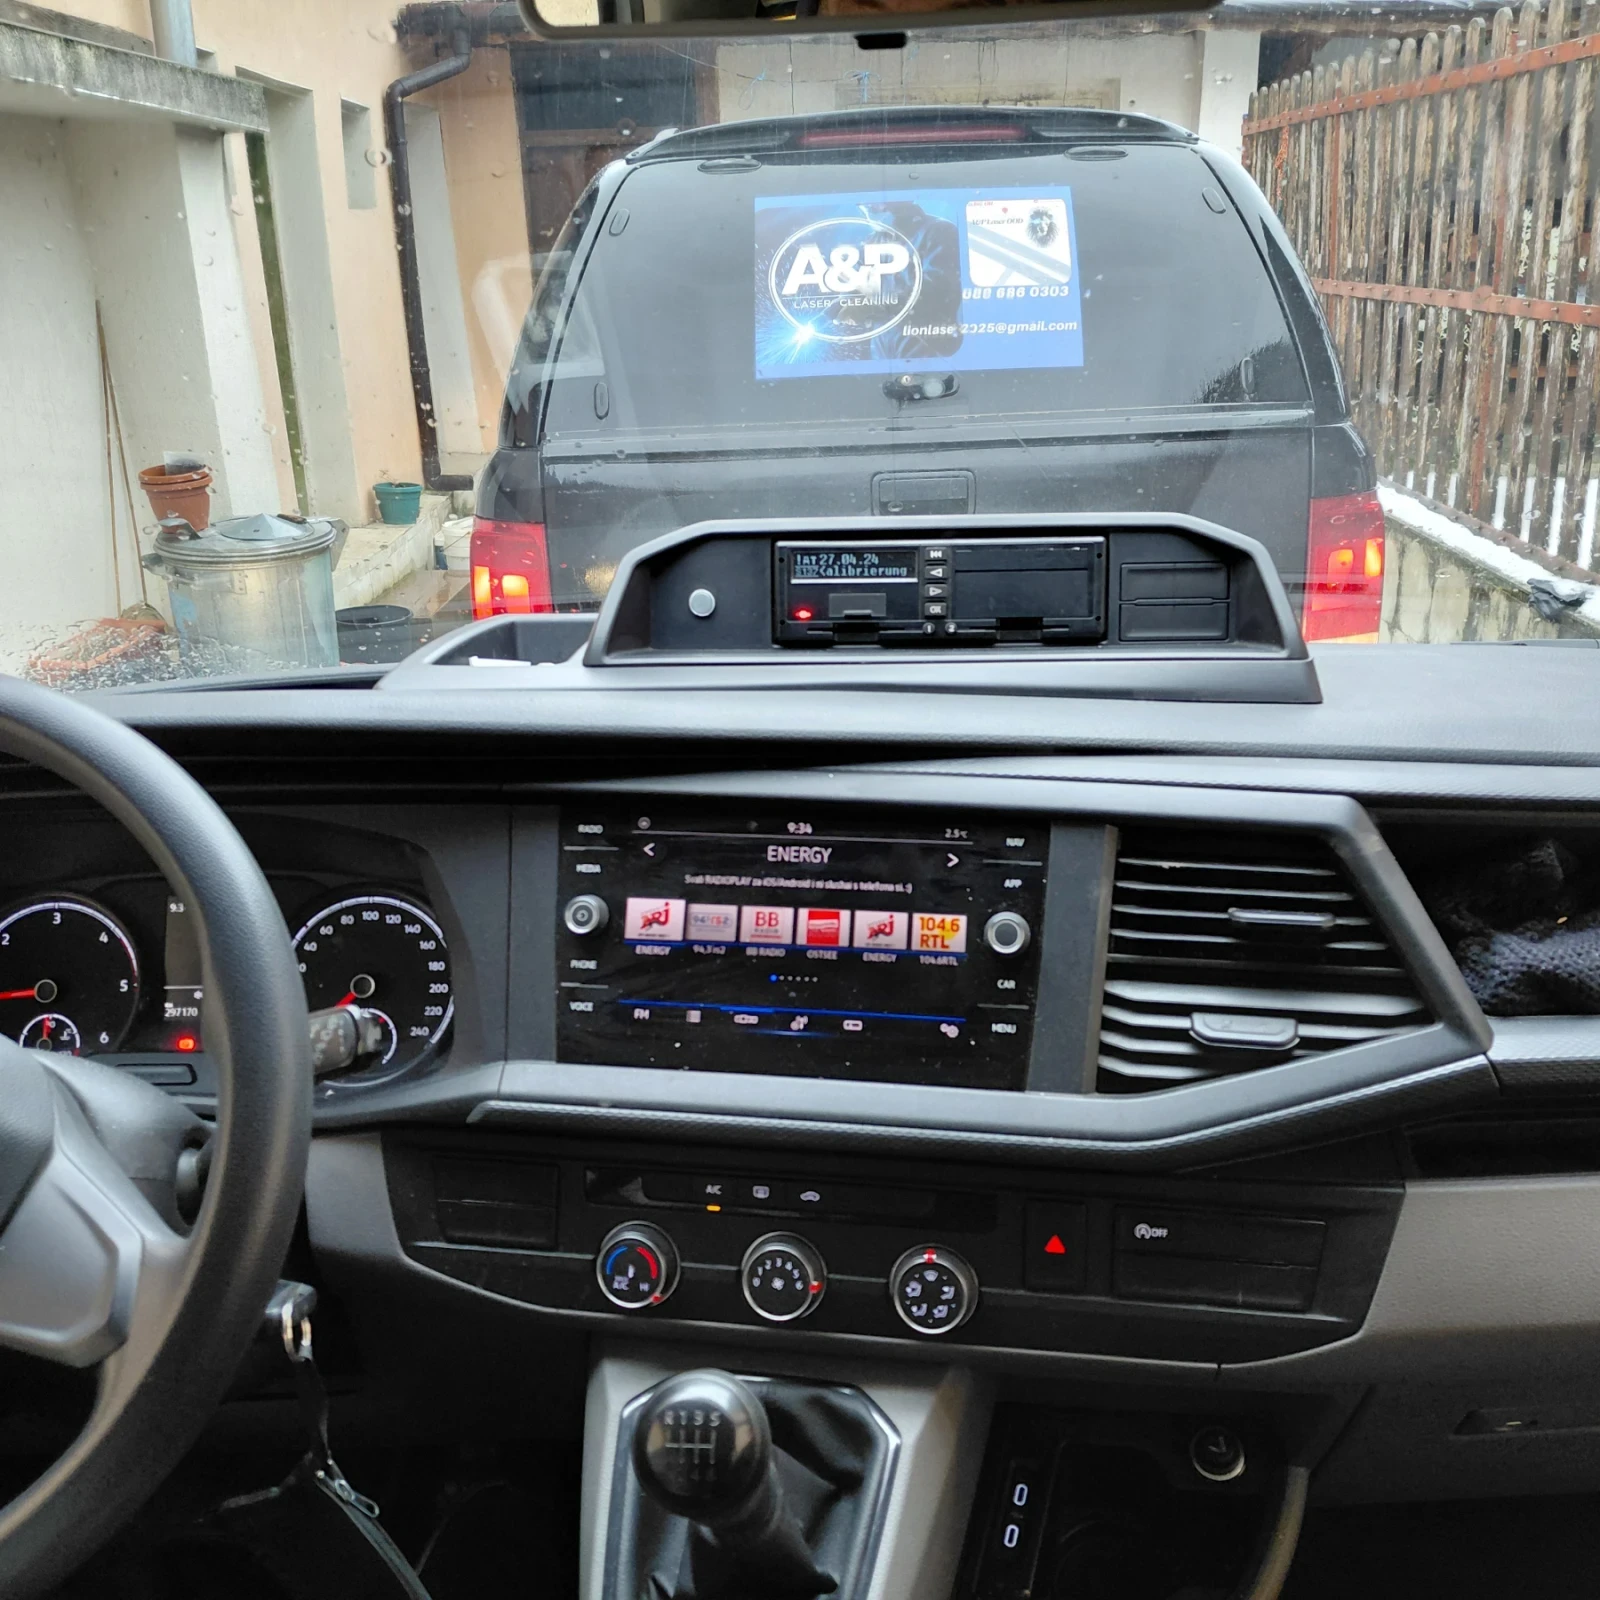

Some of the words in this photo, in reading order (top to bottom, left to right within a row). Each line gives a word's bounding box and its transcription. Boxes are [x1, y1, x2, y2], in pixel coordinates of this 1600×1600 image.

[782, 243, 910, 296] A&P
[1030, 286, 1069, 297] 0303
[794, 300, 831, 309] LASER
[840, 295, 898, 306] CLEANING
[930, 606, 942, 614] OK
[767, 845, 832, 864] ENERGY
[52, 912, 61, 924] 3
[340, 915, 354, 924] 80
[362, 910, 379, 920] 100
[385, 914, 401, 924] 120
[755, 912, 779, 927] BB
[404, 924, 421, 934] 140
[920, 916, 960, 932] 104.6
[320, 925, 334, 935] 60
[1, 934, 10, 945] 2
[99, 932, 108, 943] 4
[920, 934, 949, 949] RTL
[304, 942, 317, 951] 40
[419, 940, 436, 950] 160
[635, 945, 671, 955] ENERGY
[862, 952, 897, 962] ENERGY
[428, 962, 445, 971] 180
[119, 979, 128, 992] 5
[429, 983, 449, 994] 200
[997, 979, 1016, 989] CAR
[424, 1006, 442, 1016] 220
[569, 1001, 594, 1012] VOICE
[633, 1008, 650, 1020] FM
[410, 1026, 430, 1037] 240
[991, 1023, 1016, 1034] MENU
[100, 1032, 109, 1044] 6
[680, 1410, 687, 1425] 1
[694, 1410, 703, 1425] 3
[709, 1411, 720, 1426] 5
